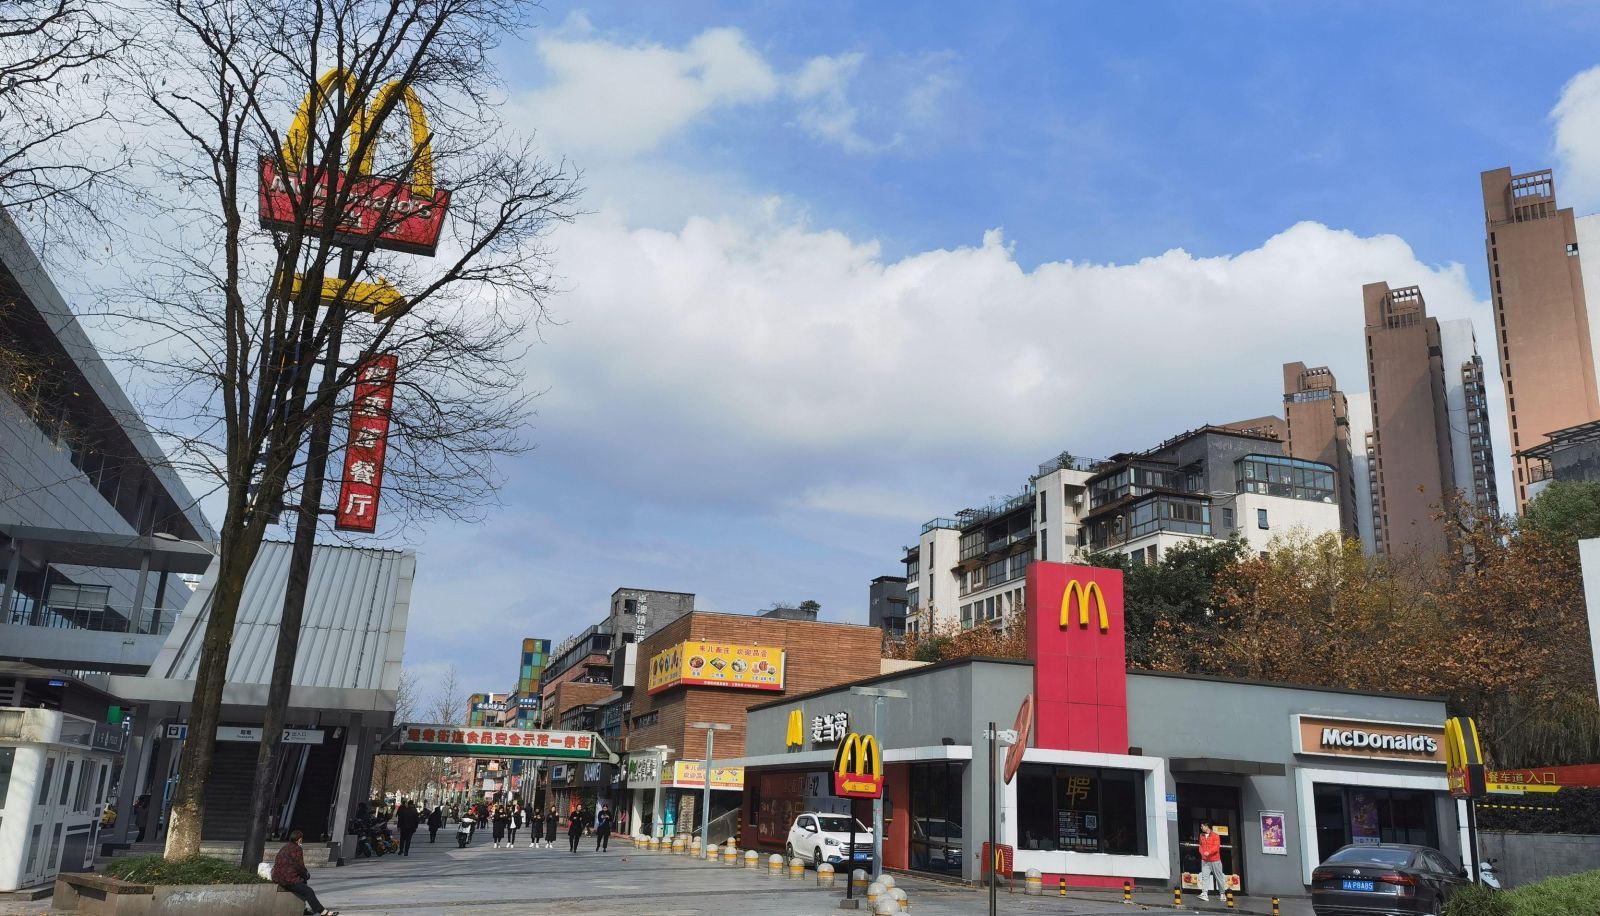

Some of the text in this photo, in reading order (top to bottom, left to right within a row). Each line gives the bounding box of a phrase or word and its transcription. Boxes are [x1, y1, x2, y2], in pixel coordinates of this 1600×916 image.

[284, 731, 290, 741] 2
[811, 712, 848, 743] 麦当劳
[1321, 728, 1438, 753] McDonald's
[1066, 775, 1091, 809] 聘
